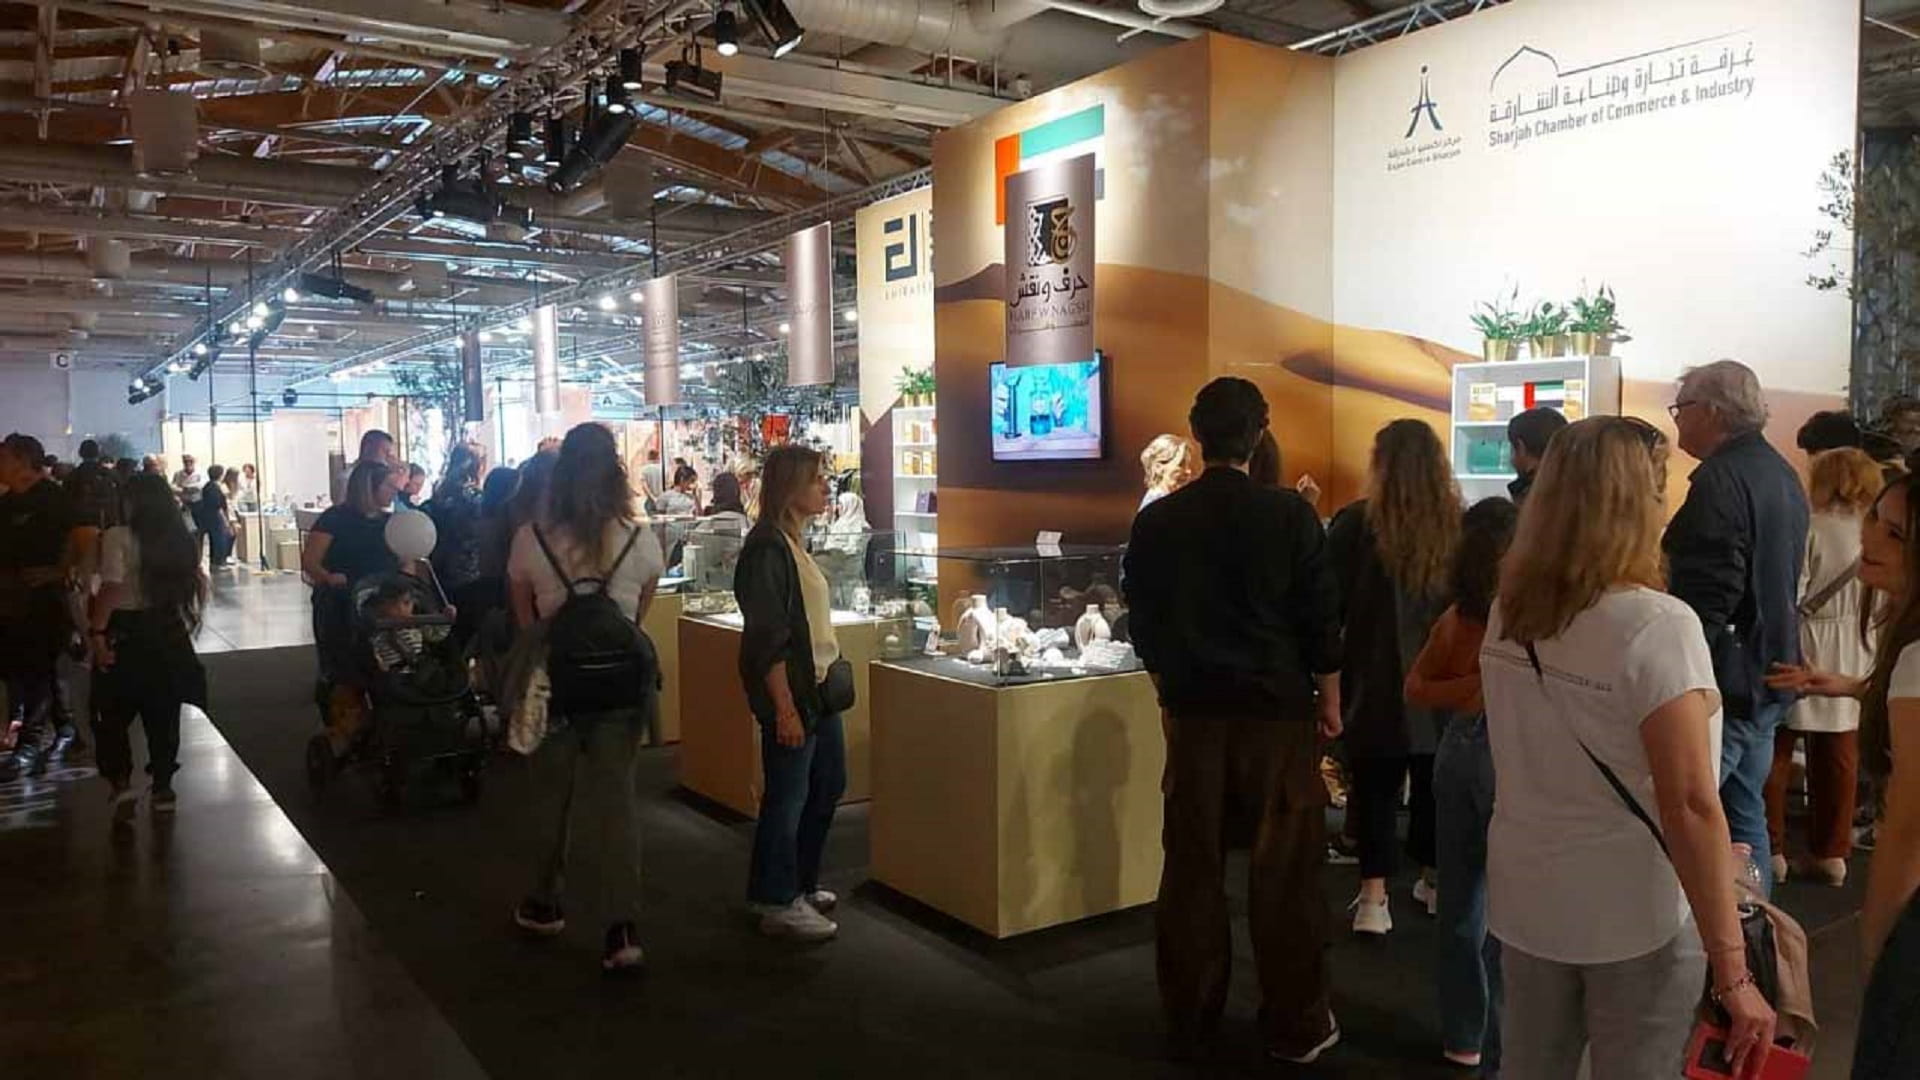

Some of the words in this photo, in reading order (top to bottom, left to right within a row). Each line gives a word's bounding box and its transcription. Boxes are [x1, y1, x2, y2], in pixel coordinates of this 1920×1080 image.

[1634, 57, 1685, 96] تجارة
[1690, 41, 1755, 76] غرفة
[1489, 122, 1532, 149] Sharjah
[1535, 112, 1588, 137] Chamber
[1591, 105, 1604, 124] of
[1606, 95, 1677, 121] Commerce
[1681, 88, 1691, 105] &
[1696, 77, 1755, 101] Industry
[1490, 84, 1559, 126] الشارقة
[1053, 267, 1089, 300] حرف
[56, 354, 69, 368] C
